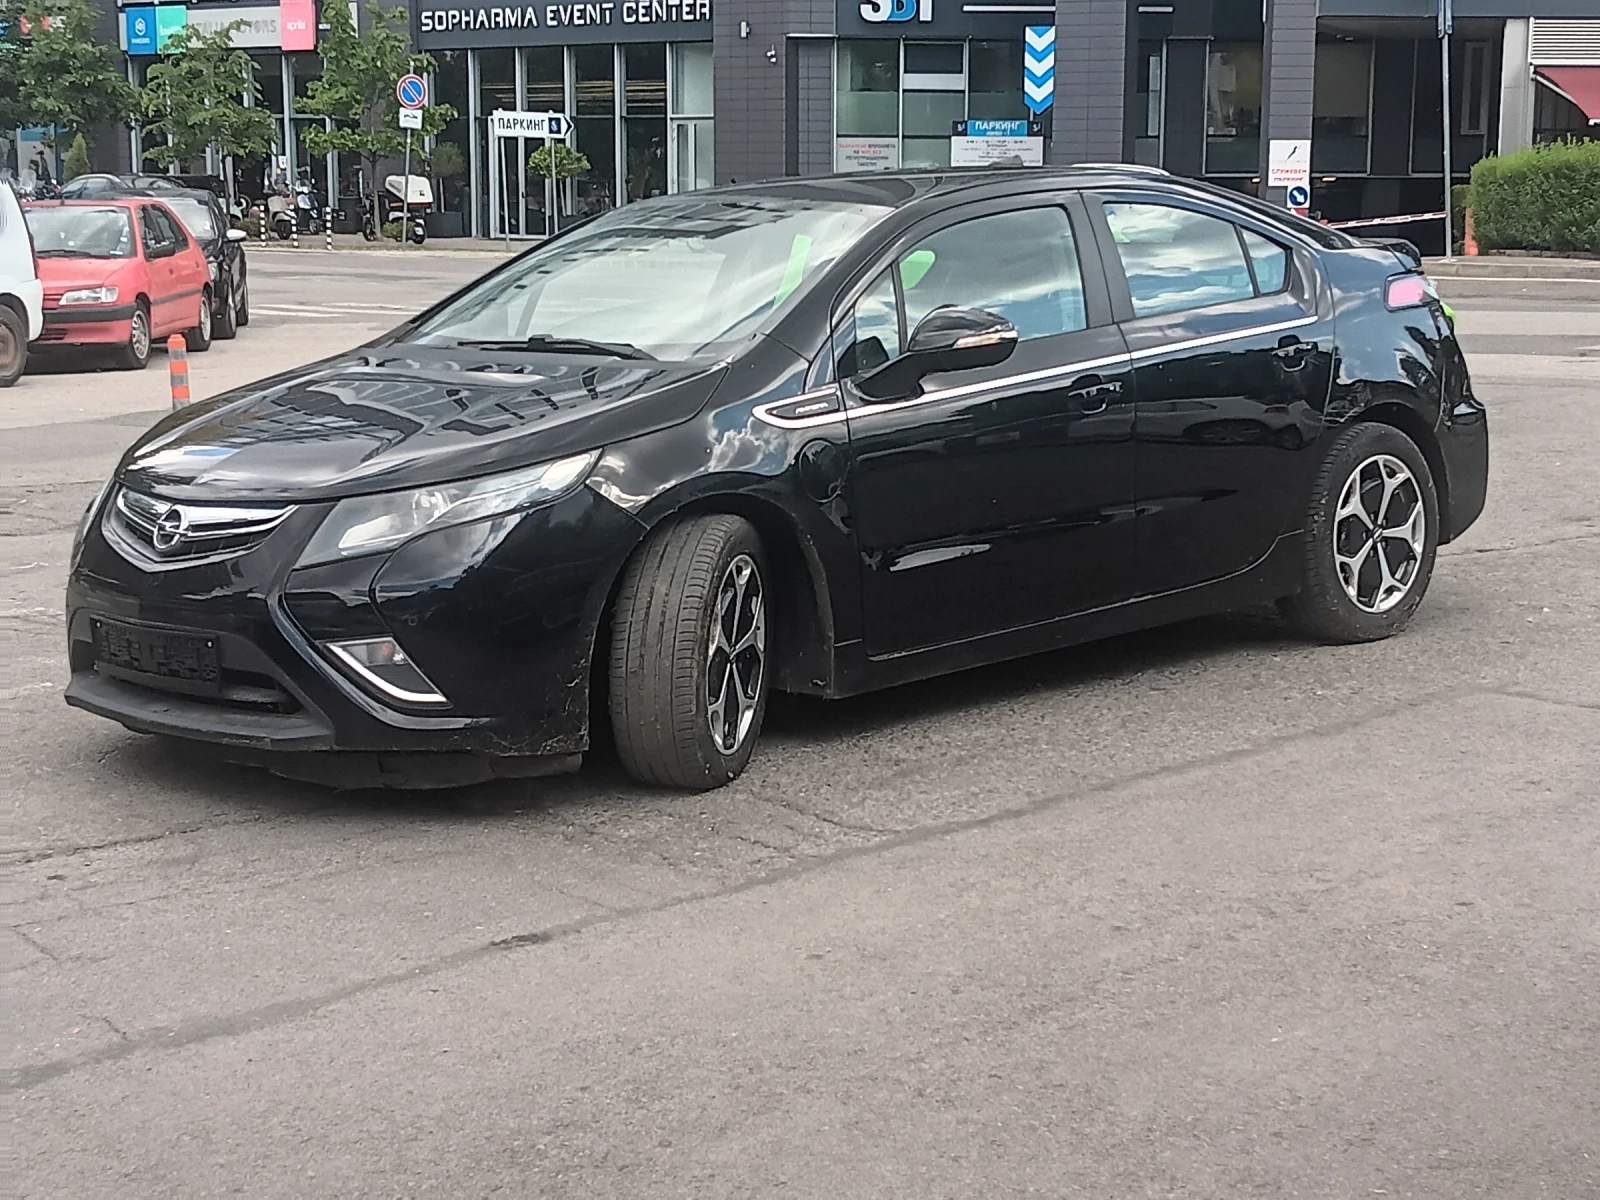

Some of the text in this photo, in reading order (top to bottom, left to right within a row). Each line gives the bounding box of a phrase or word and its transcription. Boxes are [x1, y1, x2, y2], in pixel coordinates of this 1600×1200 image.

[421, 0, 711, 31] SOPHARMA EVENT CENTER
[498, 117, 546, 131] ПАРКИНГ
[975, 121, 1021, 131] ПАРКИНГ
